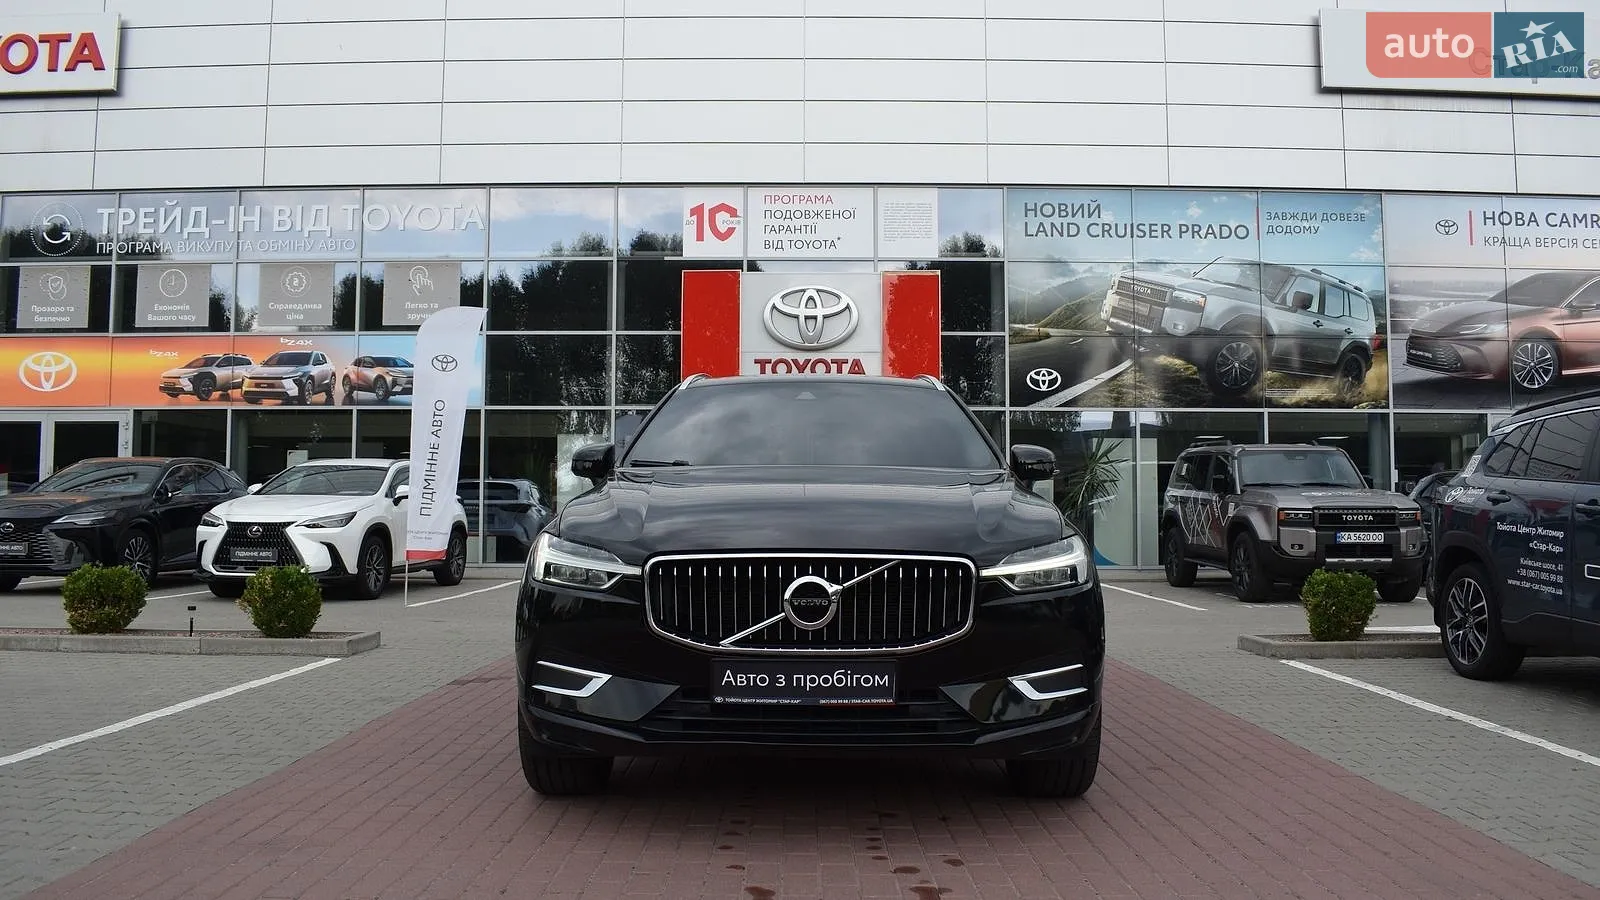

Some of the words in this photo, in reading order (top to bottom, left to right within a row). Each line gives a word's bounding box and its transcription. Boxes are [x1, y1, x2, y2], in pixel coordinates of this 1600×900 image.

[0, 31, 106, 74] OTA
[764, 194, 834, 205] ПРОГРАМА
[764, 207, 857, 221] ПОДОВЖЕНОЇ
[1024, 199, 1101, 219] НОВИЙ
[96, 200, 262, 239] ТРЕЙД-ІН
[273, 205, 332, 238] ВІД
[343, 204, 487, 231] TOYOTA
[1266, 211, 1317, 222] ЗАВЖДИ
[1320, 212, 1366, 223] ДОВЕЗЕ
[1483, 210, 1540, 227] НОВА
[764, 222, 818, 234] ГАРАНТІЇ
[1024, 222, 1081, 238] LAND
[1086, 222, 1173, 239] CRUISER
[1178, 223, 1250, 240] PRADO
[1266, 224, 1320, 235] ДОДОМУ
[96, 240, 173, 254] ПРОГРАМА
[177, 240, 234, 253] ВИКУПУ
[238, 240, 254, 252] ТА
[257, 239, 314, 252] ОБМІНУ
[318, 238, 356, 251] АВТО
[764, 239, 785, 251] ВІД
[1484, 236, 1531, 249] КРАЩА
[1535, 237, 1578, 249] ВЕРСІЯ
[1582, 238, 1600, 249] СЕ
[31, 304, 65, 314] Прозоро
[154, 303, 190, 311] Економія
[268, 302, 322, 311] Справедлива
[34, 314, 71, 323] безпечно
[147, 313, 178, 322] Вашого
[178, 314, 197, 323] часу
[286, 312, 304, 321] ціна
[754, 358, 866, 375] TOYOTA
[419, 442, 440, 517] ПІДМІННЕ
[431, 399, 445, 439] АВТО
[1496, 521, 1516, 531] Тойота
[1517, 524, 1536, 536] Центр
[1537, 526, 1564, 540] Житомир
[721, 669, 769, 687] Авто
[775, 674, 786, 687] з
[793, 669, 889, 691] пробігом
